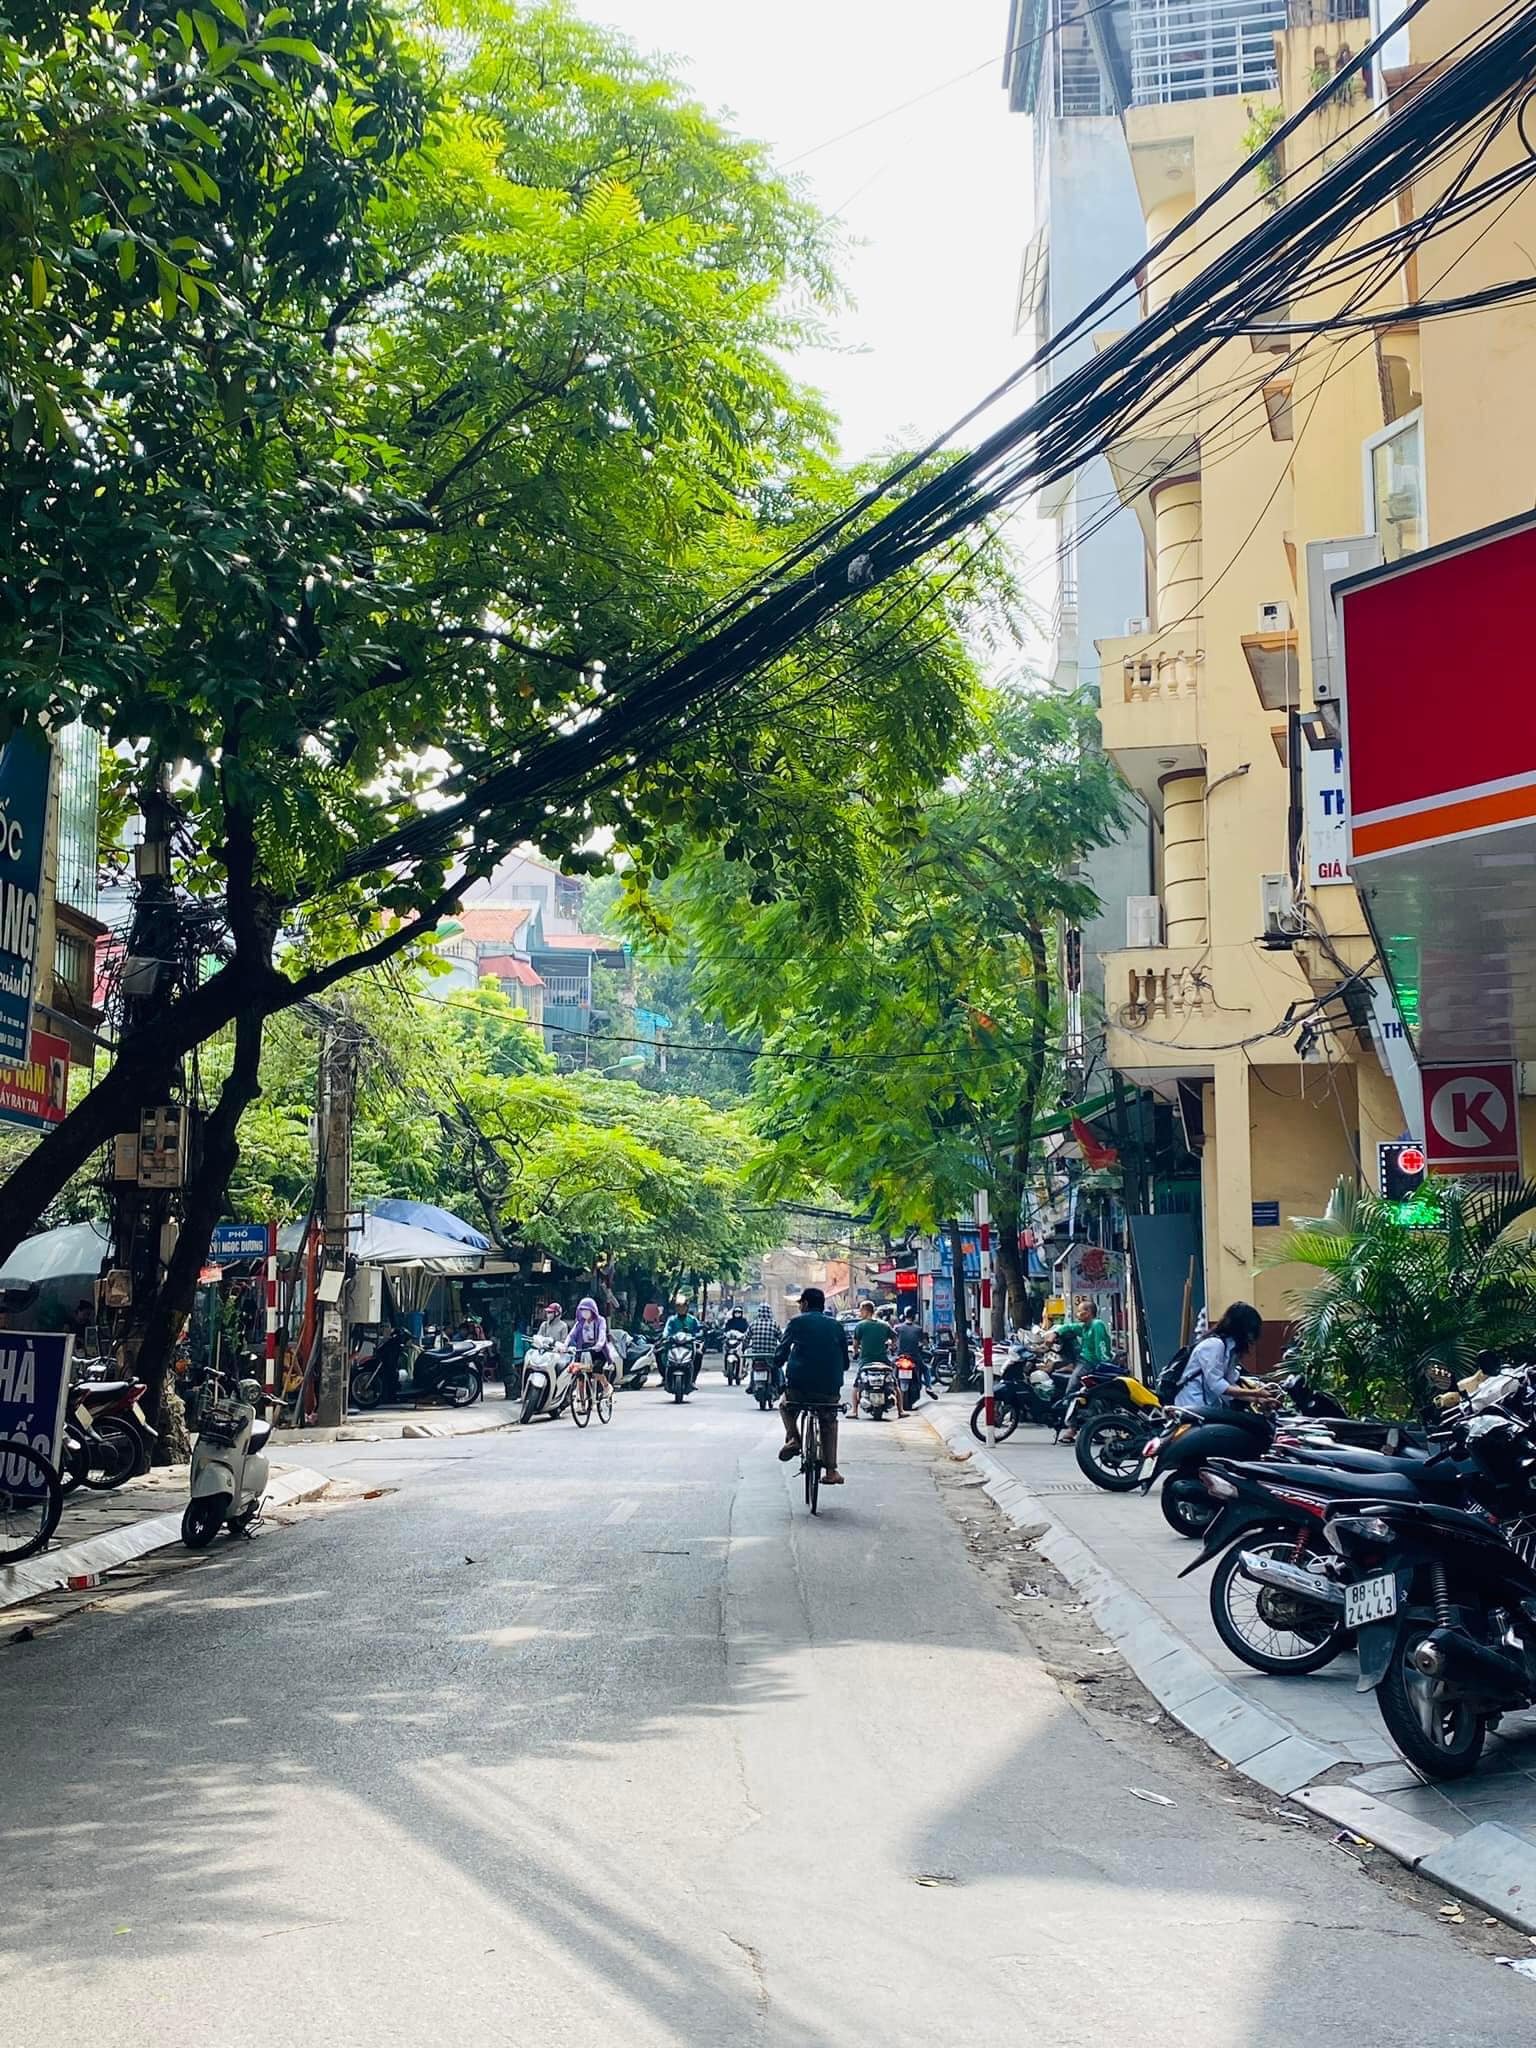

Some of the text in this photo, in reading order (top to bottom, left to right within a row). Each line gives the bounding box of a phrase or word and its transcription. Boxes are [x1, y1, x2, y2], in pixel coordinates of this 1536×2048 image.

[1452, 1092, 1502, 1142] K
[228, 1227, 248, 1238] PHỐ
[1348, 1596, 1393, 1625] 244.43
